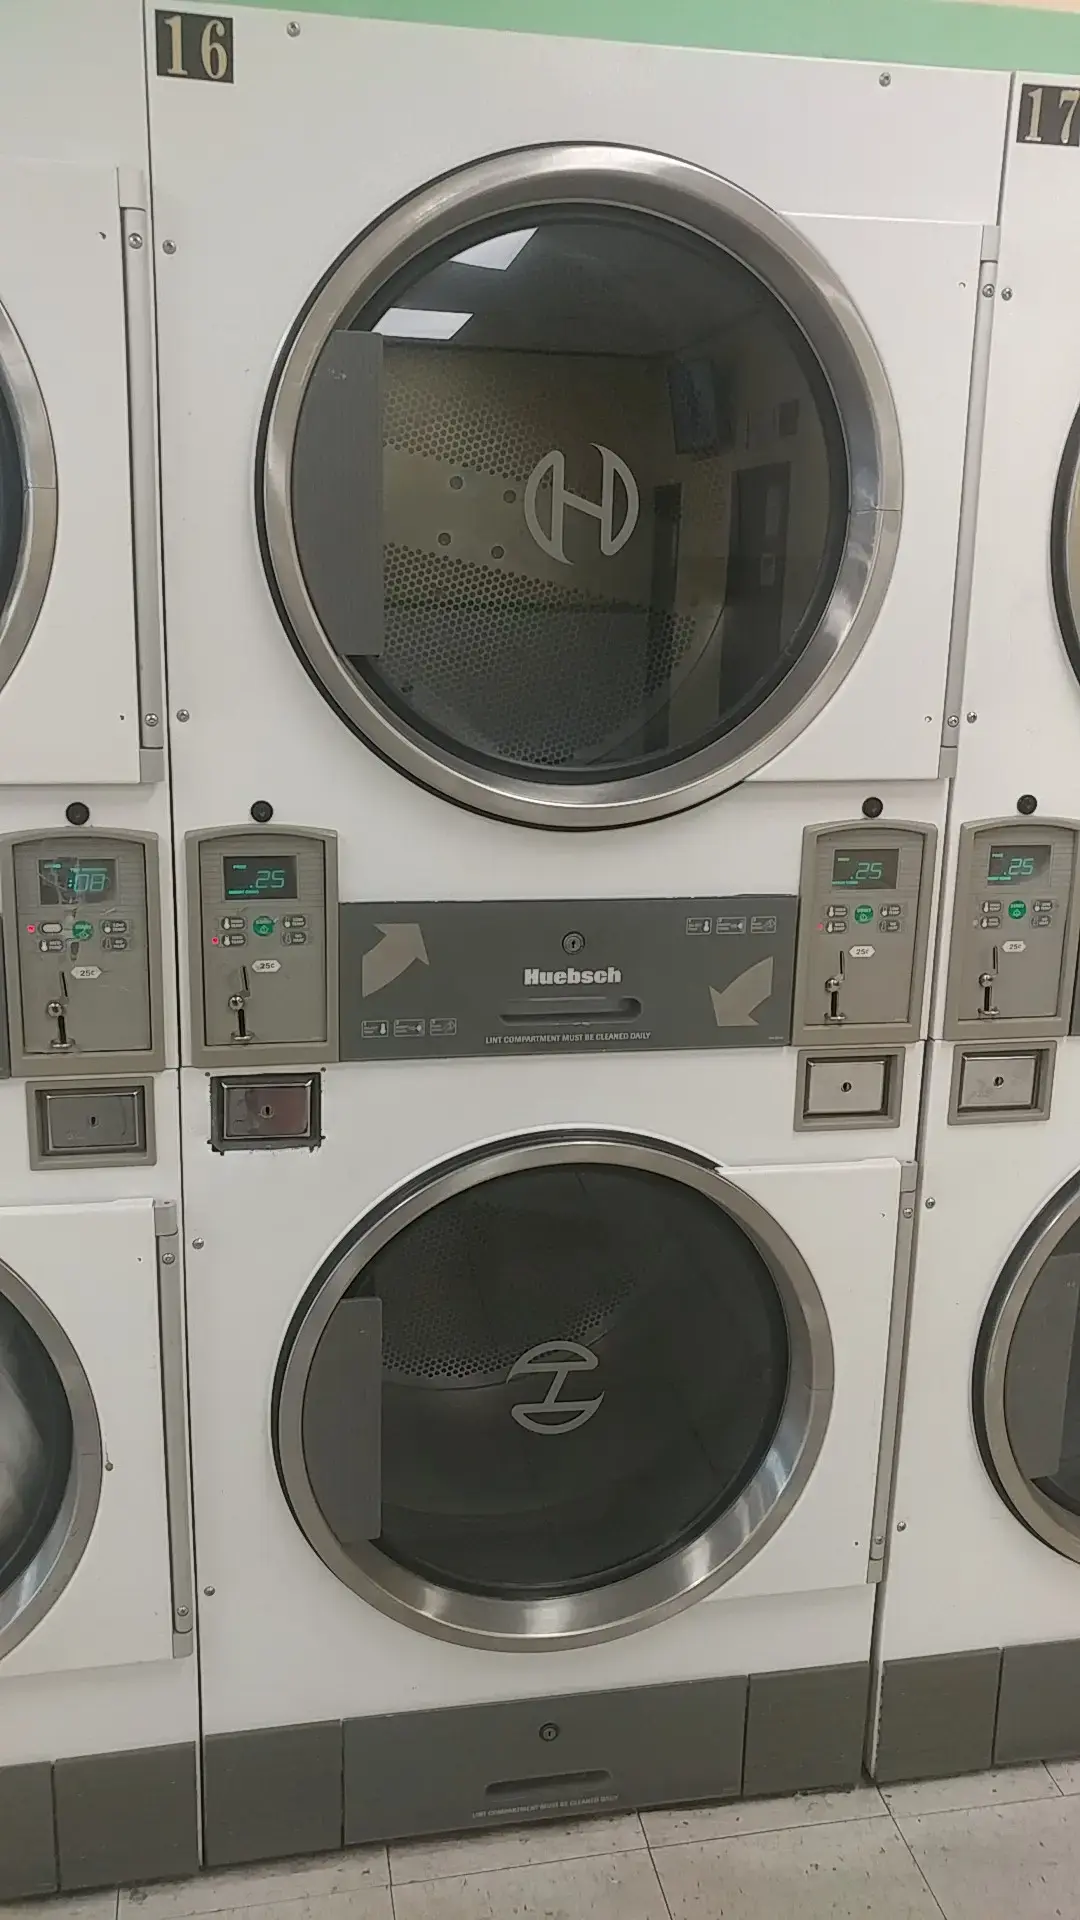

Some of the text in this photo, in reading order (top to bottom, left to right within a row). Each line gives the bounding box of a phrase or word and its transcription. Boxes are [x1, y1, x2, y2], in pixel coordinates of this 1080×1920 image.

[163, 14, 228, 79] 16
[1024, 88, 1080, 144] 17
[249, 869, 286, 889] .25
[849, 862, 883, 880] .25
[523, 966, 622, 986] Huebsch
[485, 1031, 652, 1045] LINT COMPARTMENT MUST BE CLEANED DAILY
